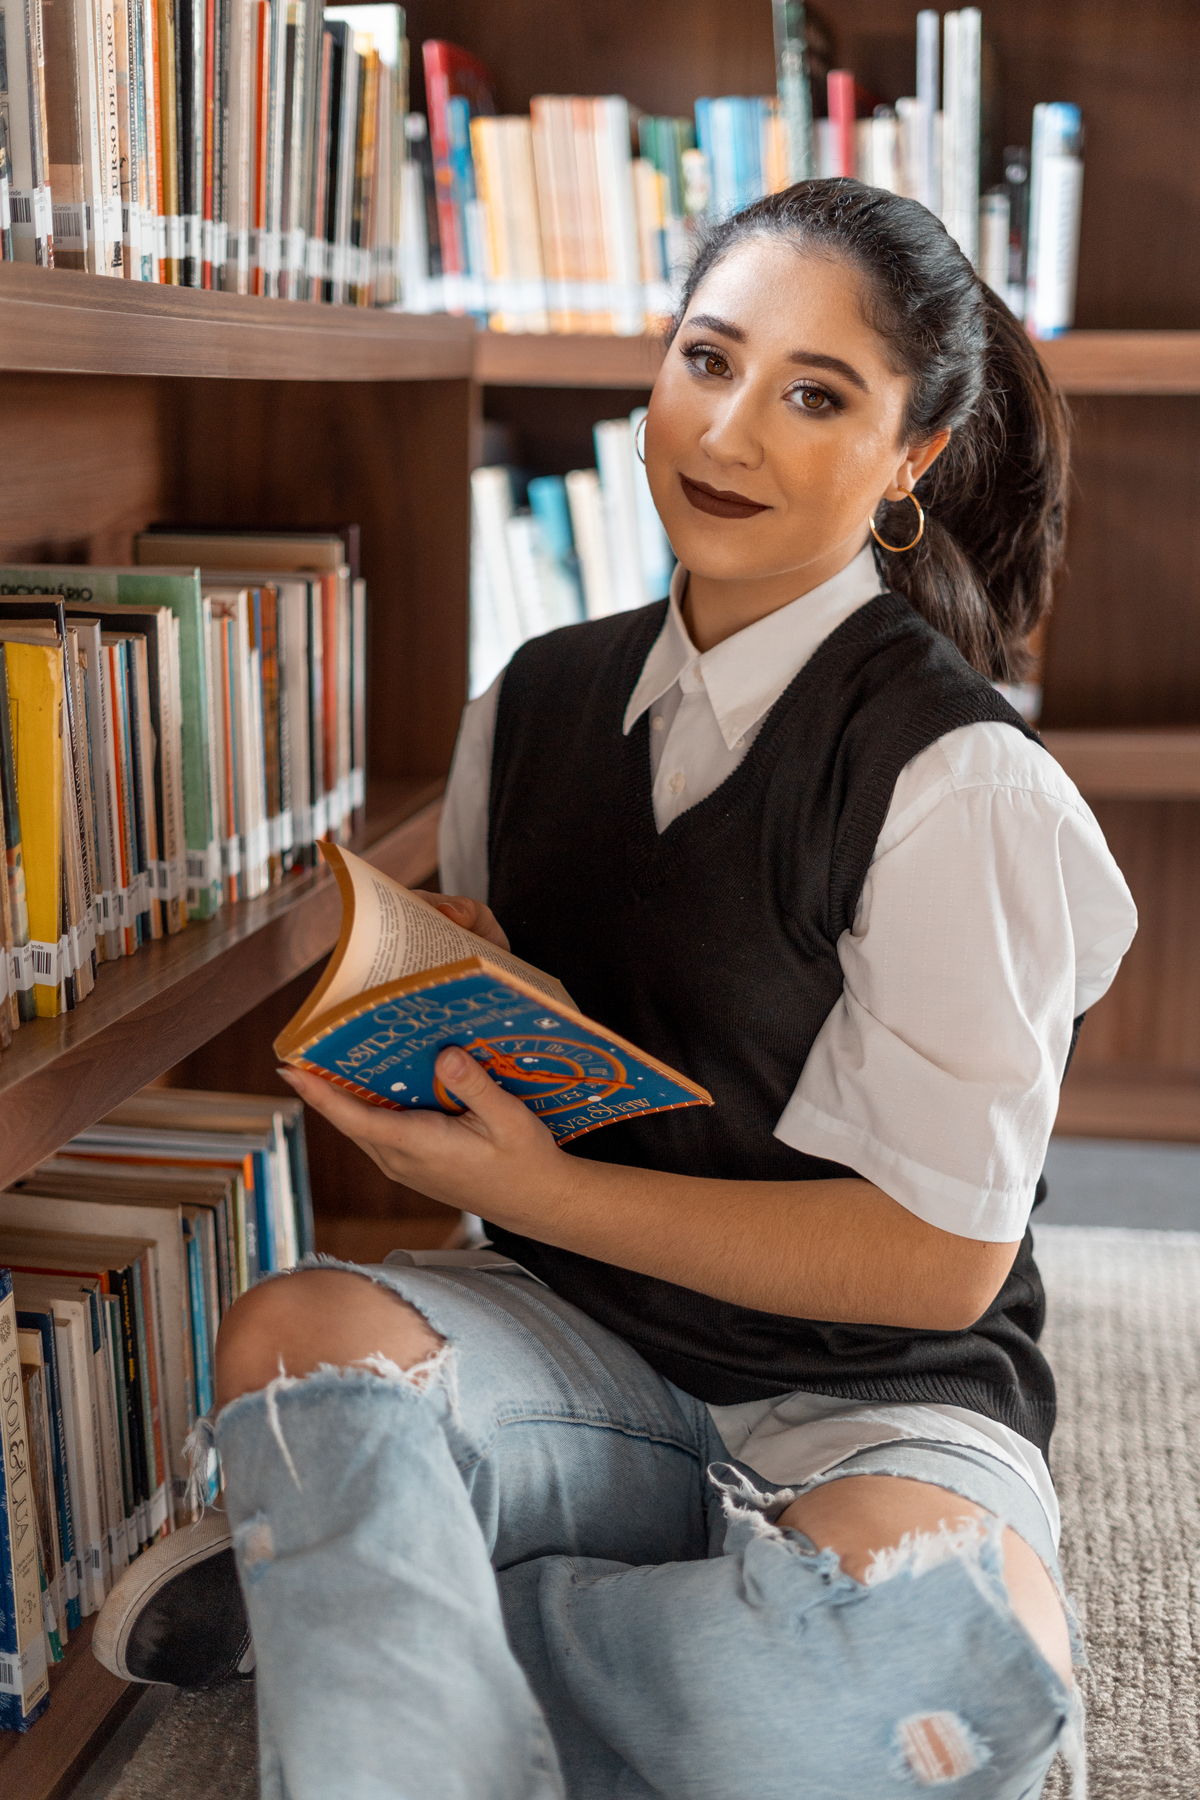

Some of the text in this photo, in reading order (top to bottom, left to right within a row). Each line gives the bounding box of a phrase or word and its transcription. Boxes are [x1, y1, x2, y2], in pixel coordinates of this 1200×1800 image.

[104, 12, 115, 78] TARÔ
[107, 85, 116, 116] DE
[72, 760, 84, 832] ASTROLOGIA
[80, 838, 86, 854] DE
[398, 1048, 413, 1058] a
[405, 1031, 448, 1051] Boa
[354, 1054, 401, 1083] Para
[549, 1098, 651, 1137] Eva Shaw
[55, 1409, 67, 1465] POEMAS
